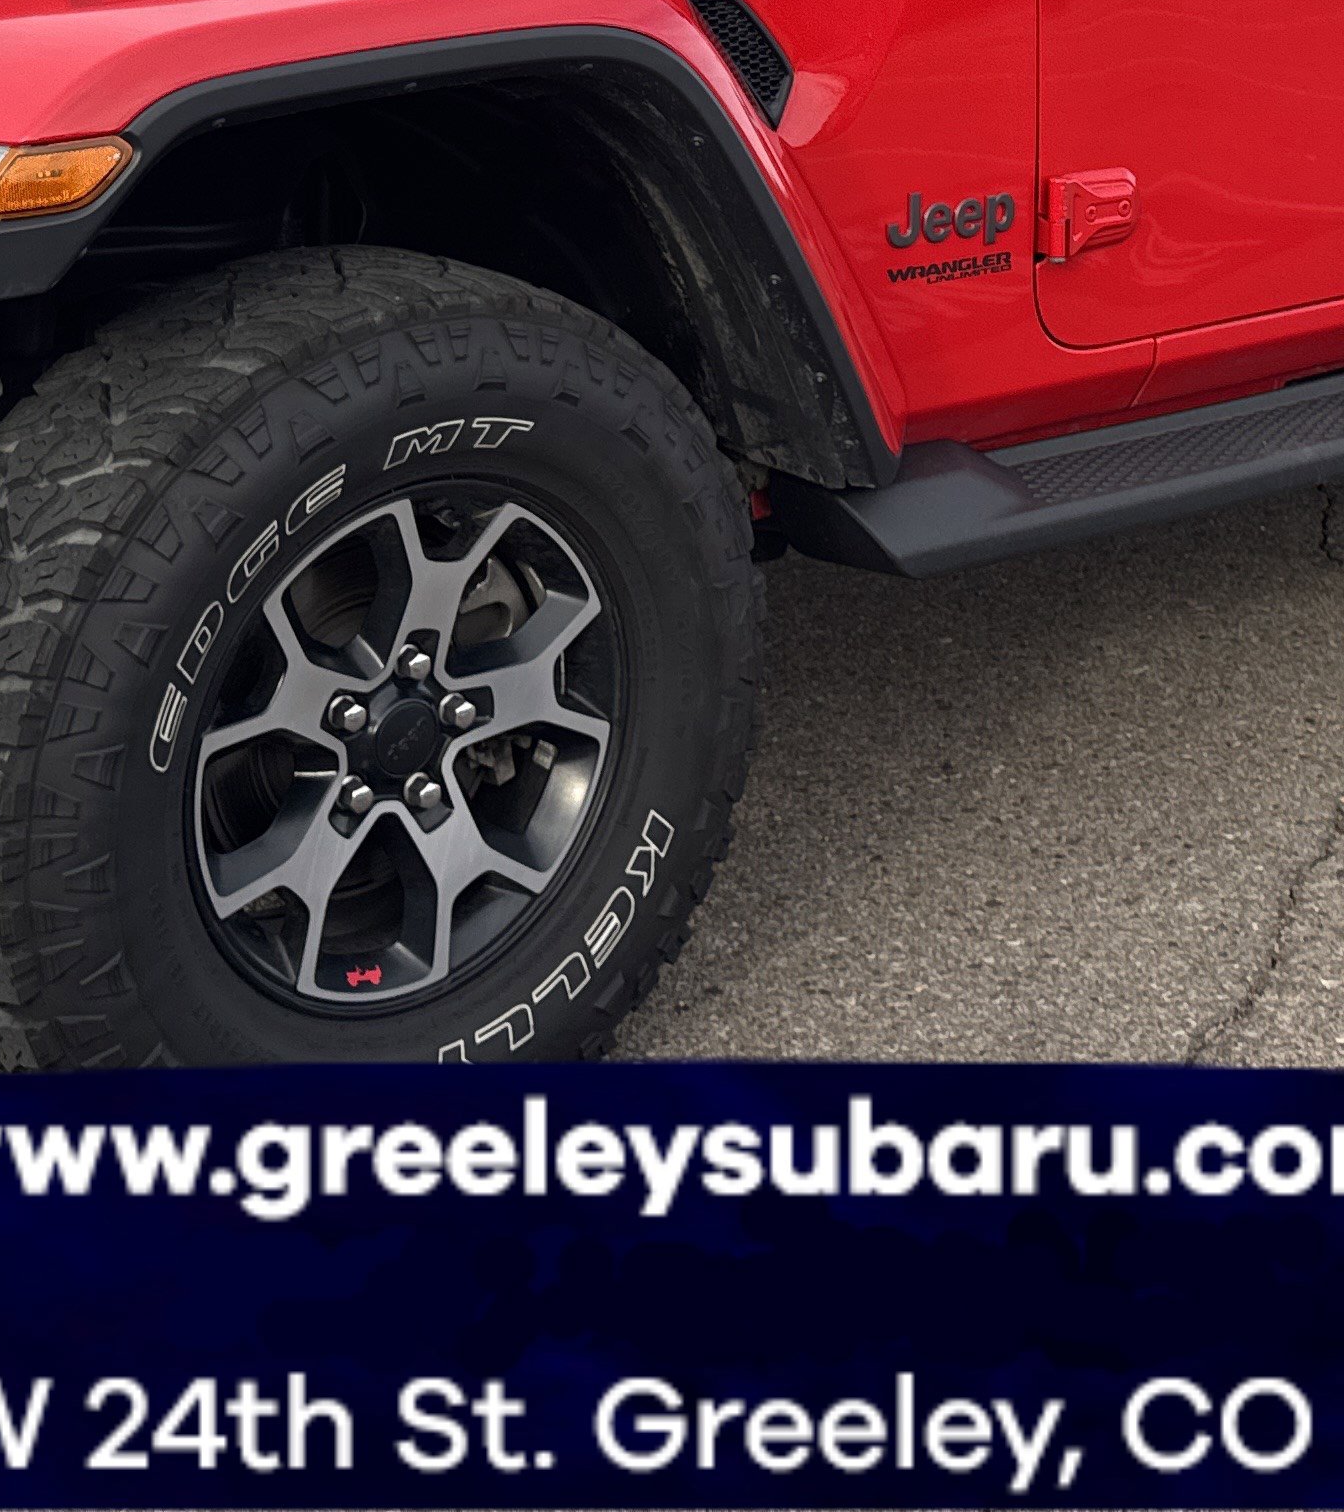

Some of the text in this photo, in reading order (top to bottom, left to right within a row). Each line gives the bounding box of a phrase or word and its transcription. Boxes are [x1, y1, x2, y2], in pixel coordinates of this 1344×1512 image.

[886, 192, 1015, 248] Jeep
[886, 251, 1011, 283] WRANGLER
[926, 264, 1012, 284] UNLIMITED
[150, 417, 534, 772] EDGE MT
